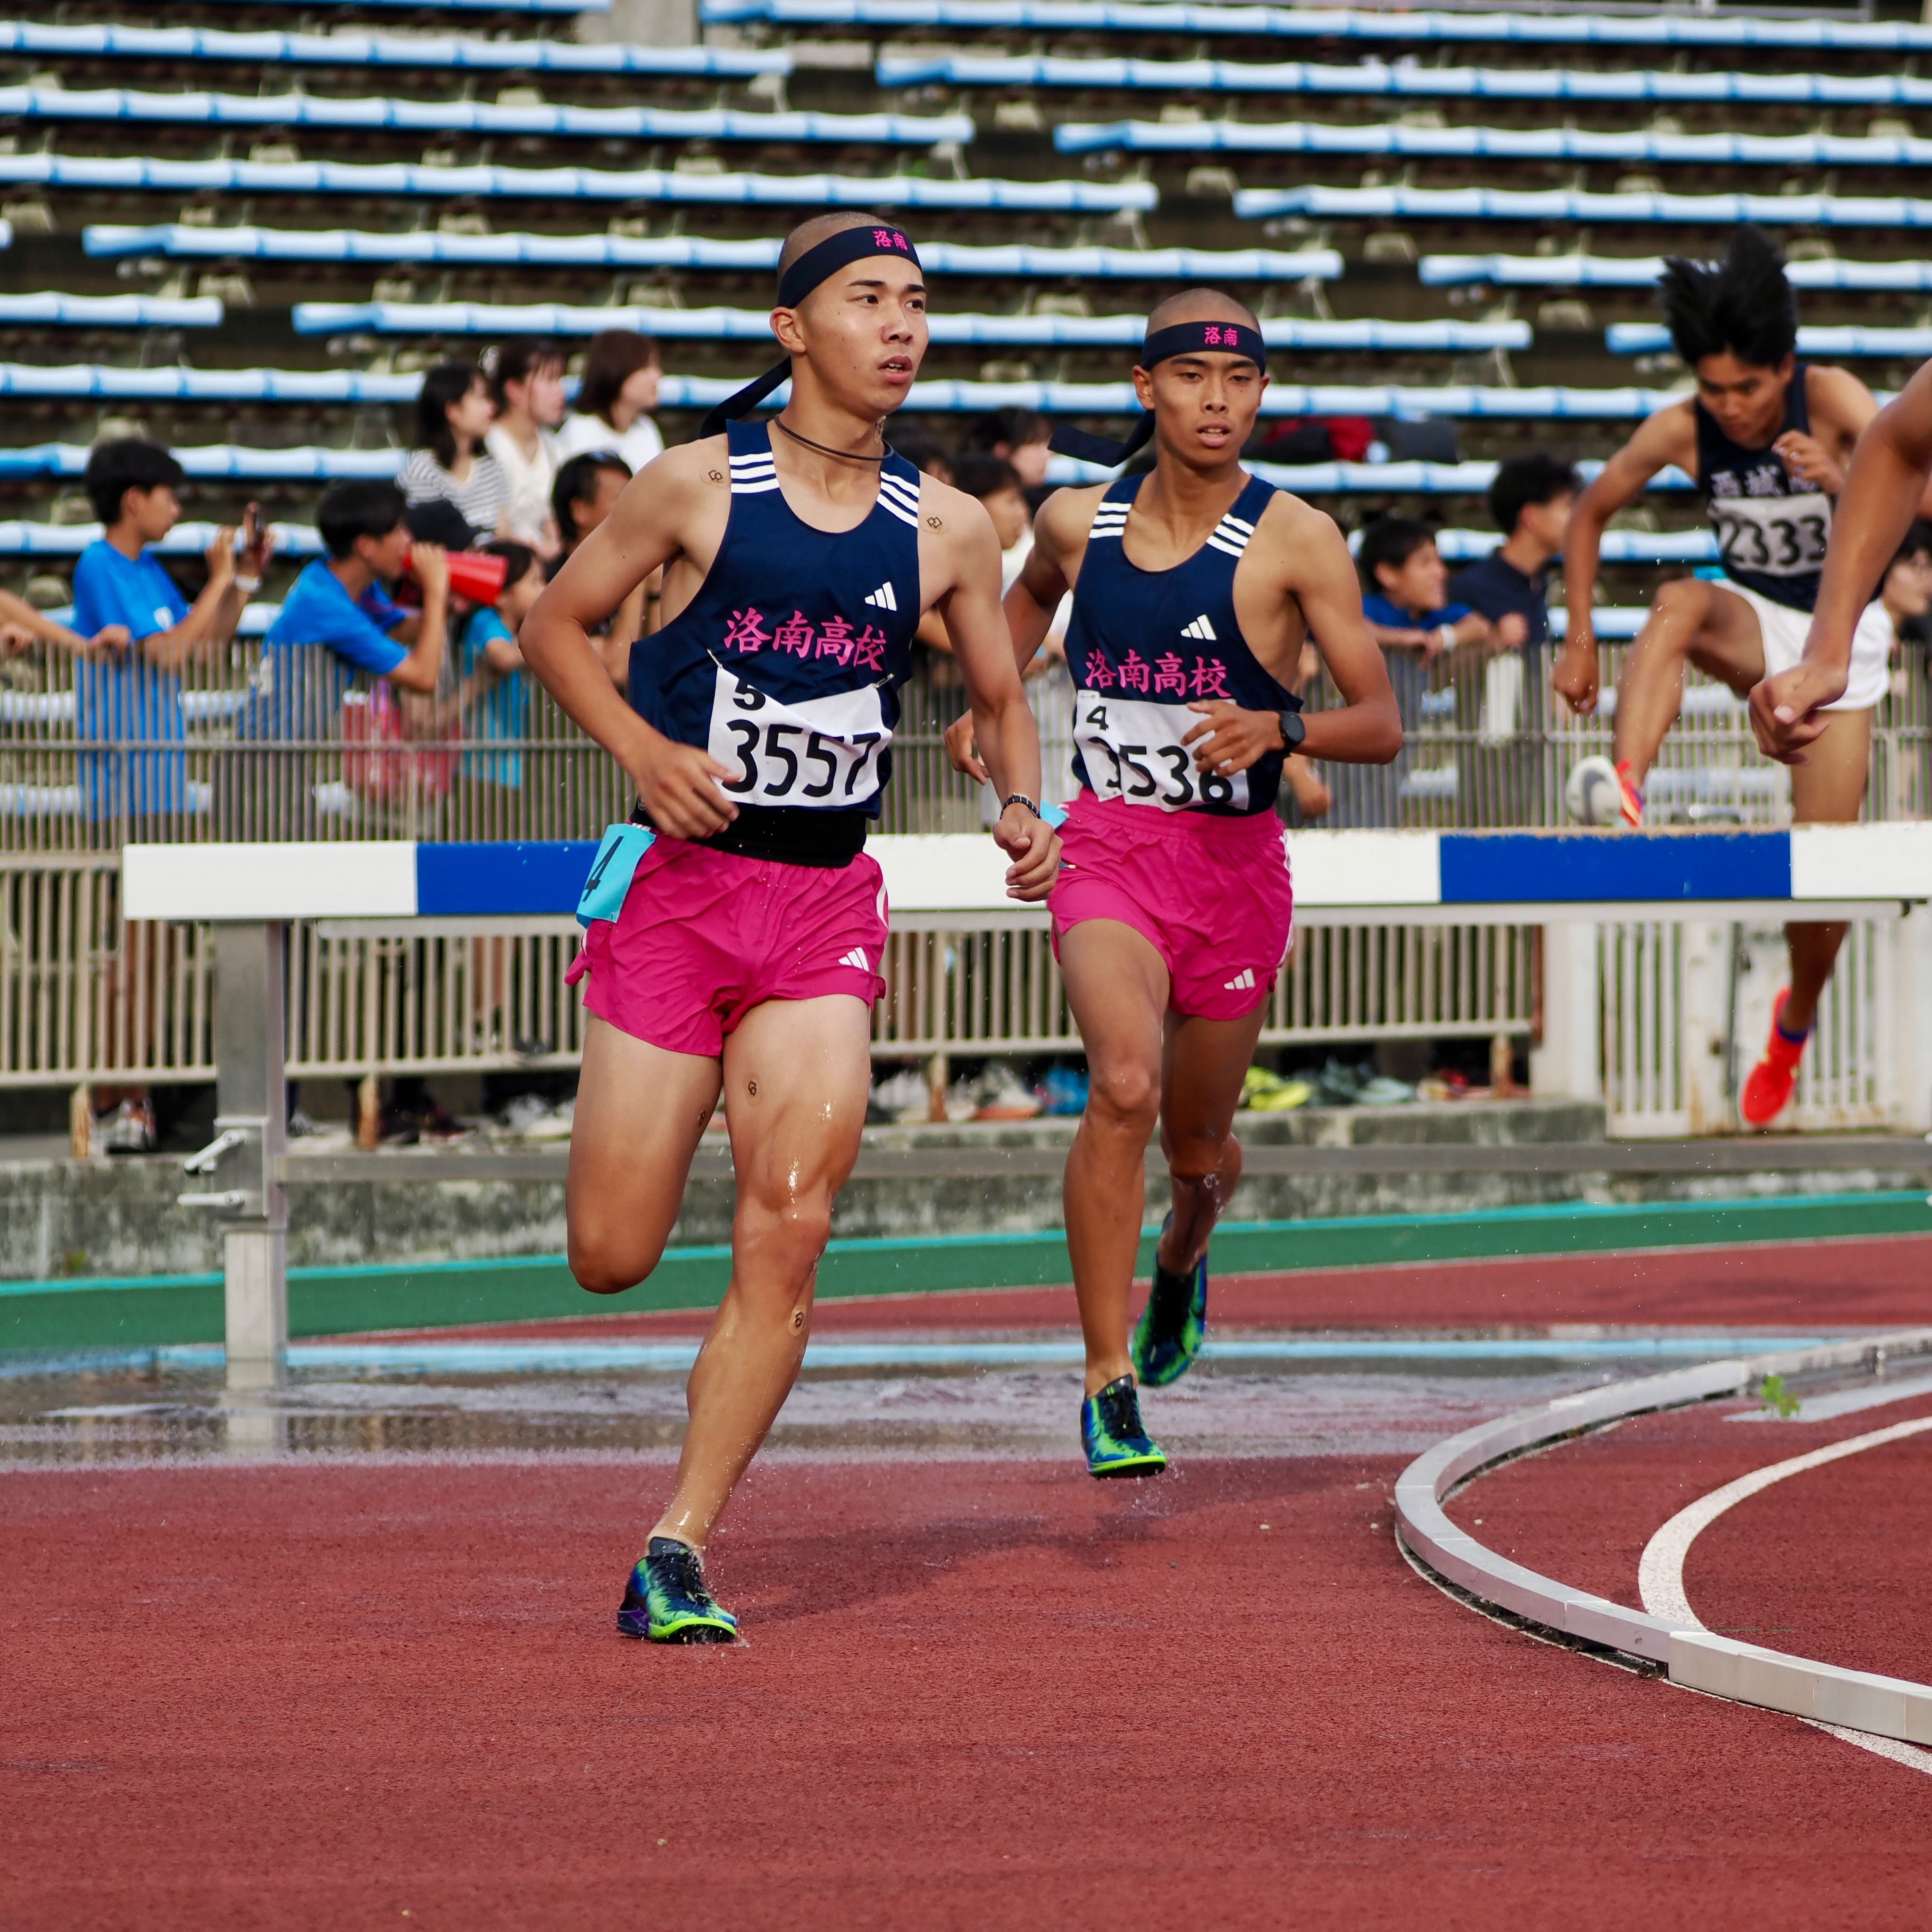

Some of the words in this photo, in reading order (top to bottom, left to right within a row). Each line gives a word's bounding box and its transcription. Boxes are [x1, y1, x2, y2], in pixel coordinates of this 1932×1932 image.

[872, 230, 908, 251] 洛南
[1204, 326, 1239, 347] 洛南
[1718, 515, 1828, 565] 2333
[723, 607, 886, 671] 洛南高校
[1085, 648, 1232, 698] 洛南高校
[1086, 705, 1108, 730] 4
[721, 719, 882, 797] 3557
[582, 836, 625, 902] 4
